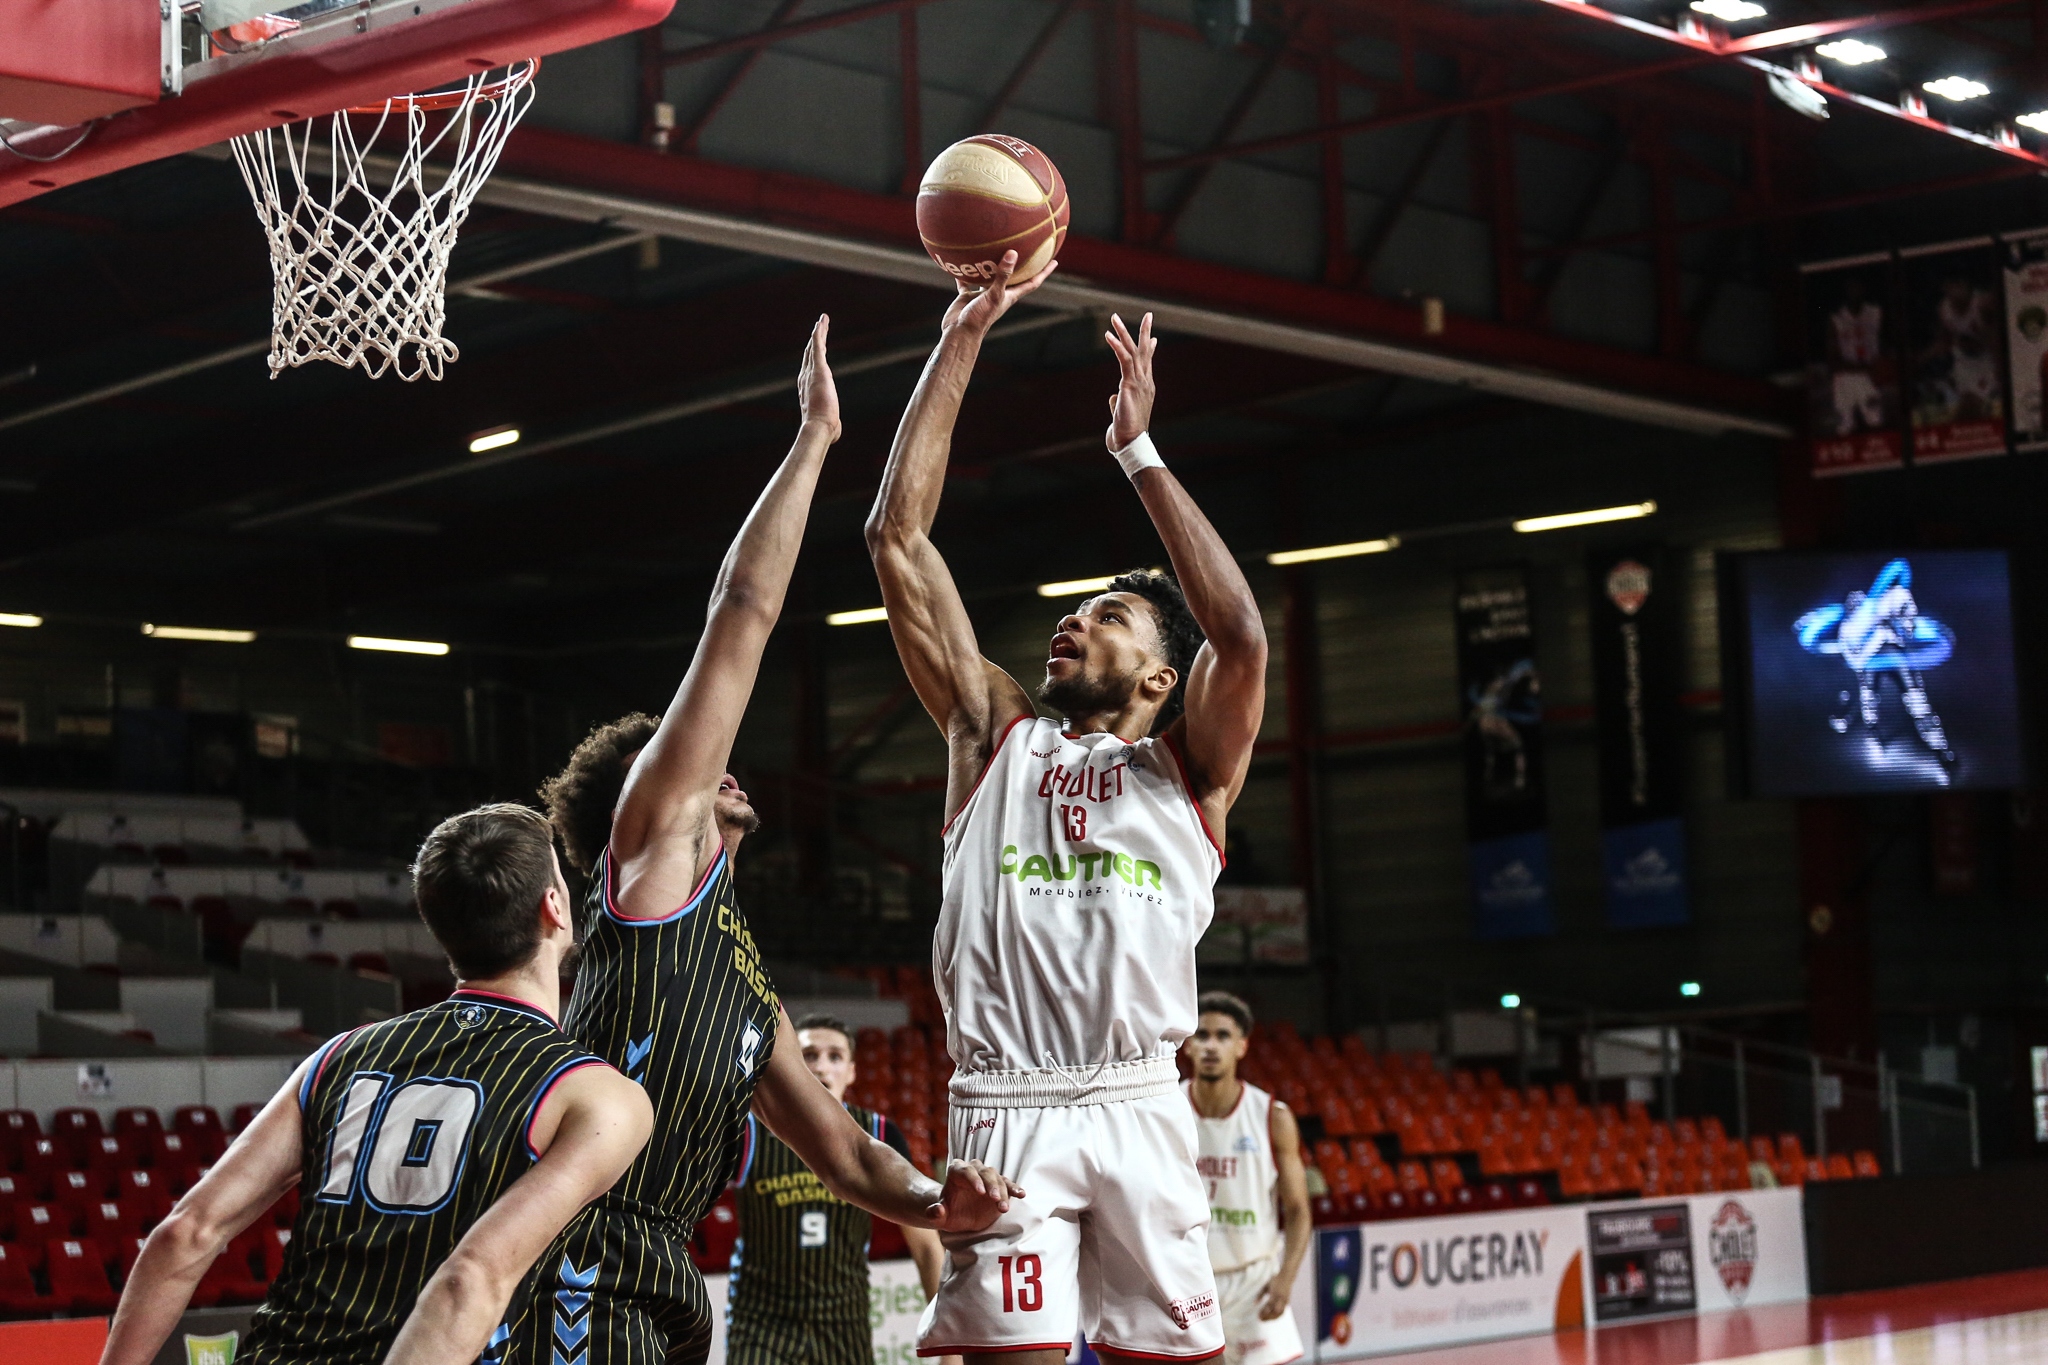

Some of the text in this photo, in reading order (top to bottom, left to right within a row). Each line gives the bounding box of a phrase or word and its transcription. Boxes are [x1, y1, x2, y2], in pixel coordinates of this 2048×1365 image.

[935, 253, 998, 280] Jeep
[1038, 763, 1126, 803] CHOLET
[1060, 803, 1088, 842] 13
[318, 1071, 484, 1214] 10
[801, 1212, 827, 1247] 9
[1369, 1228, 1548, 1292] FOUGERAY
[998, 1254, 1043, 1313] 13
